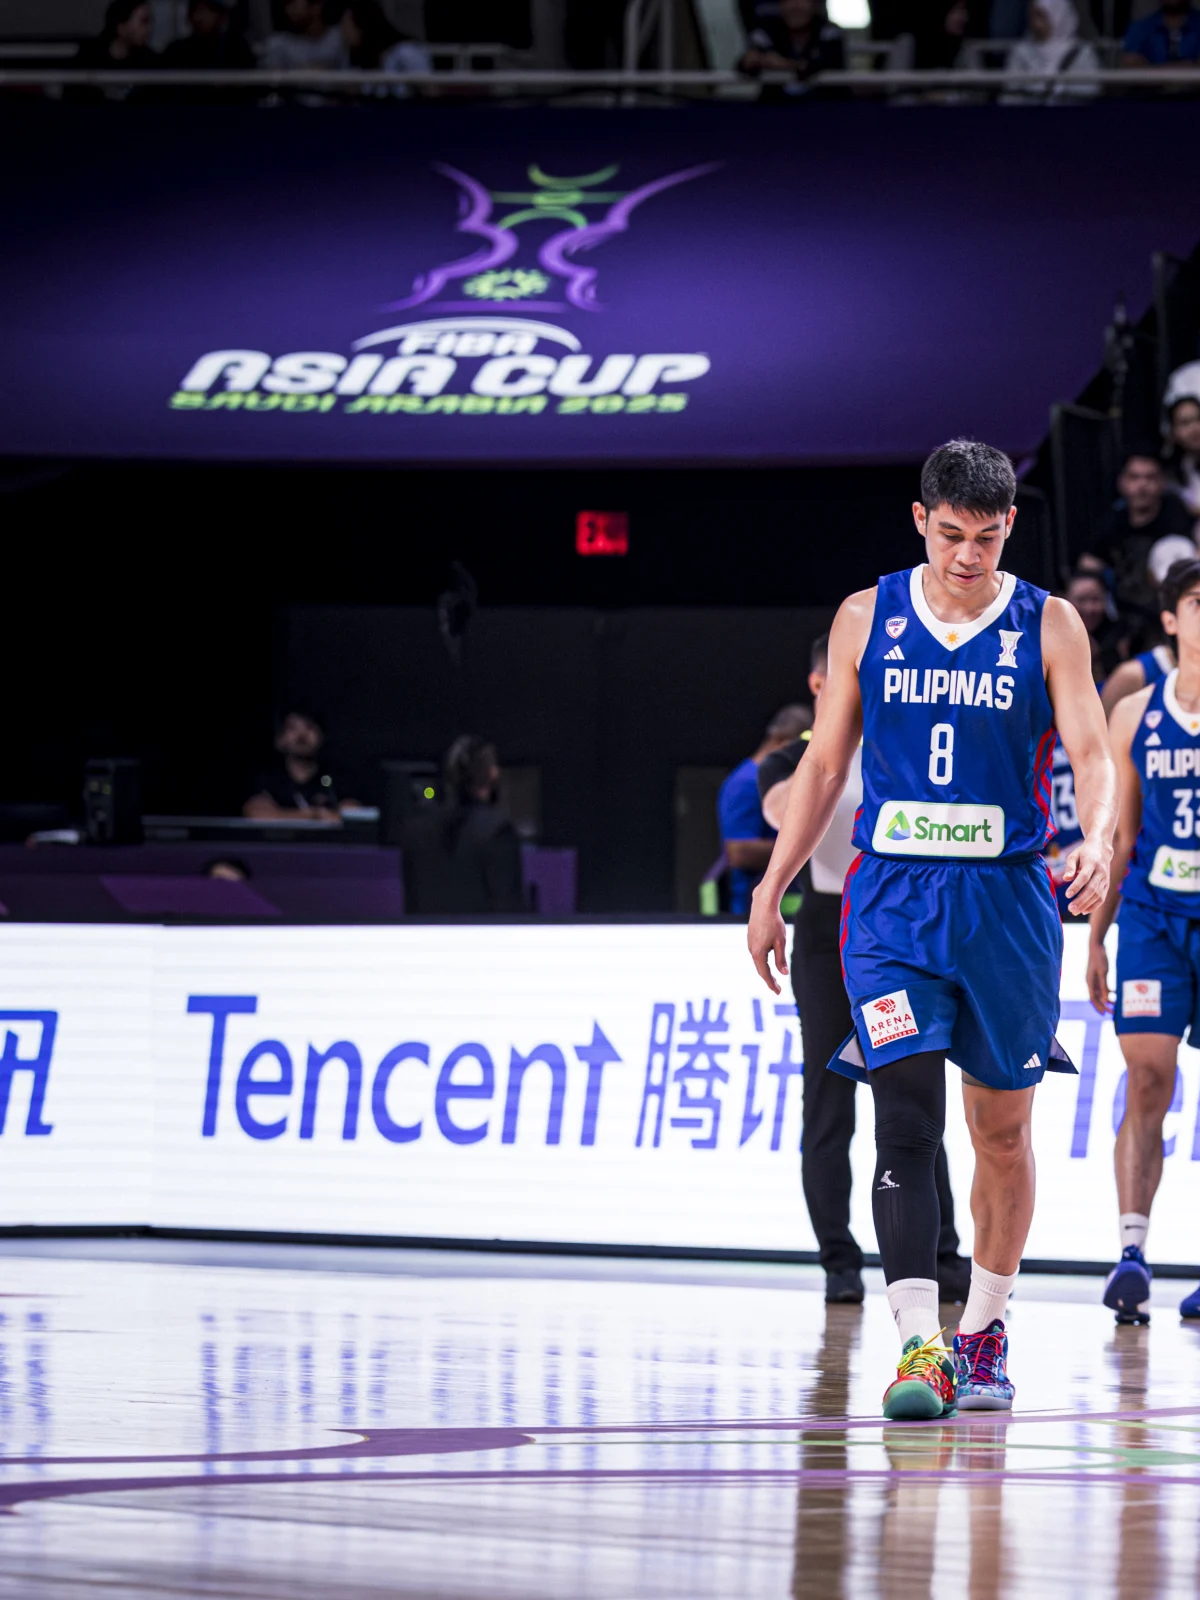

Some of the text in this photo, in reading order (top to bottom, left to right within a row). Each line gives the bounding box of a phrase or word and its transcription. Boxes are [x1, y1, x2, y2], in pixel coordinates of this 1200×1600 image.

[180, 349, 711, 397] ASIA CUP
[169, 391, 689, 414] SAUDI ARABIA 2025
[884, 668, 1015, 710] PILIPINAS
[928, 723, 954, 785] 8
[914, 816, 992, 843] Smart
[871, 1014, 912, 1034] ARENA
[879, 1024, 907, 1037] PLUS
[187, 995, 624, 1147] Tencent
